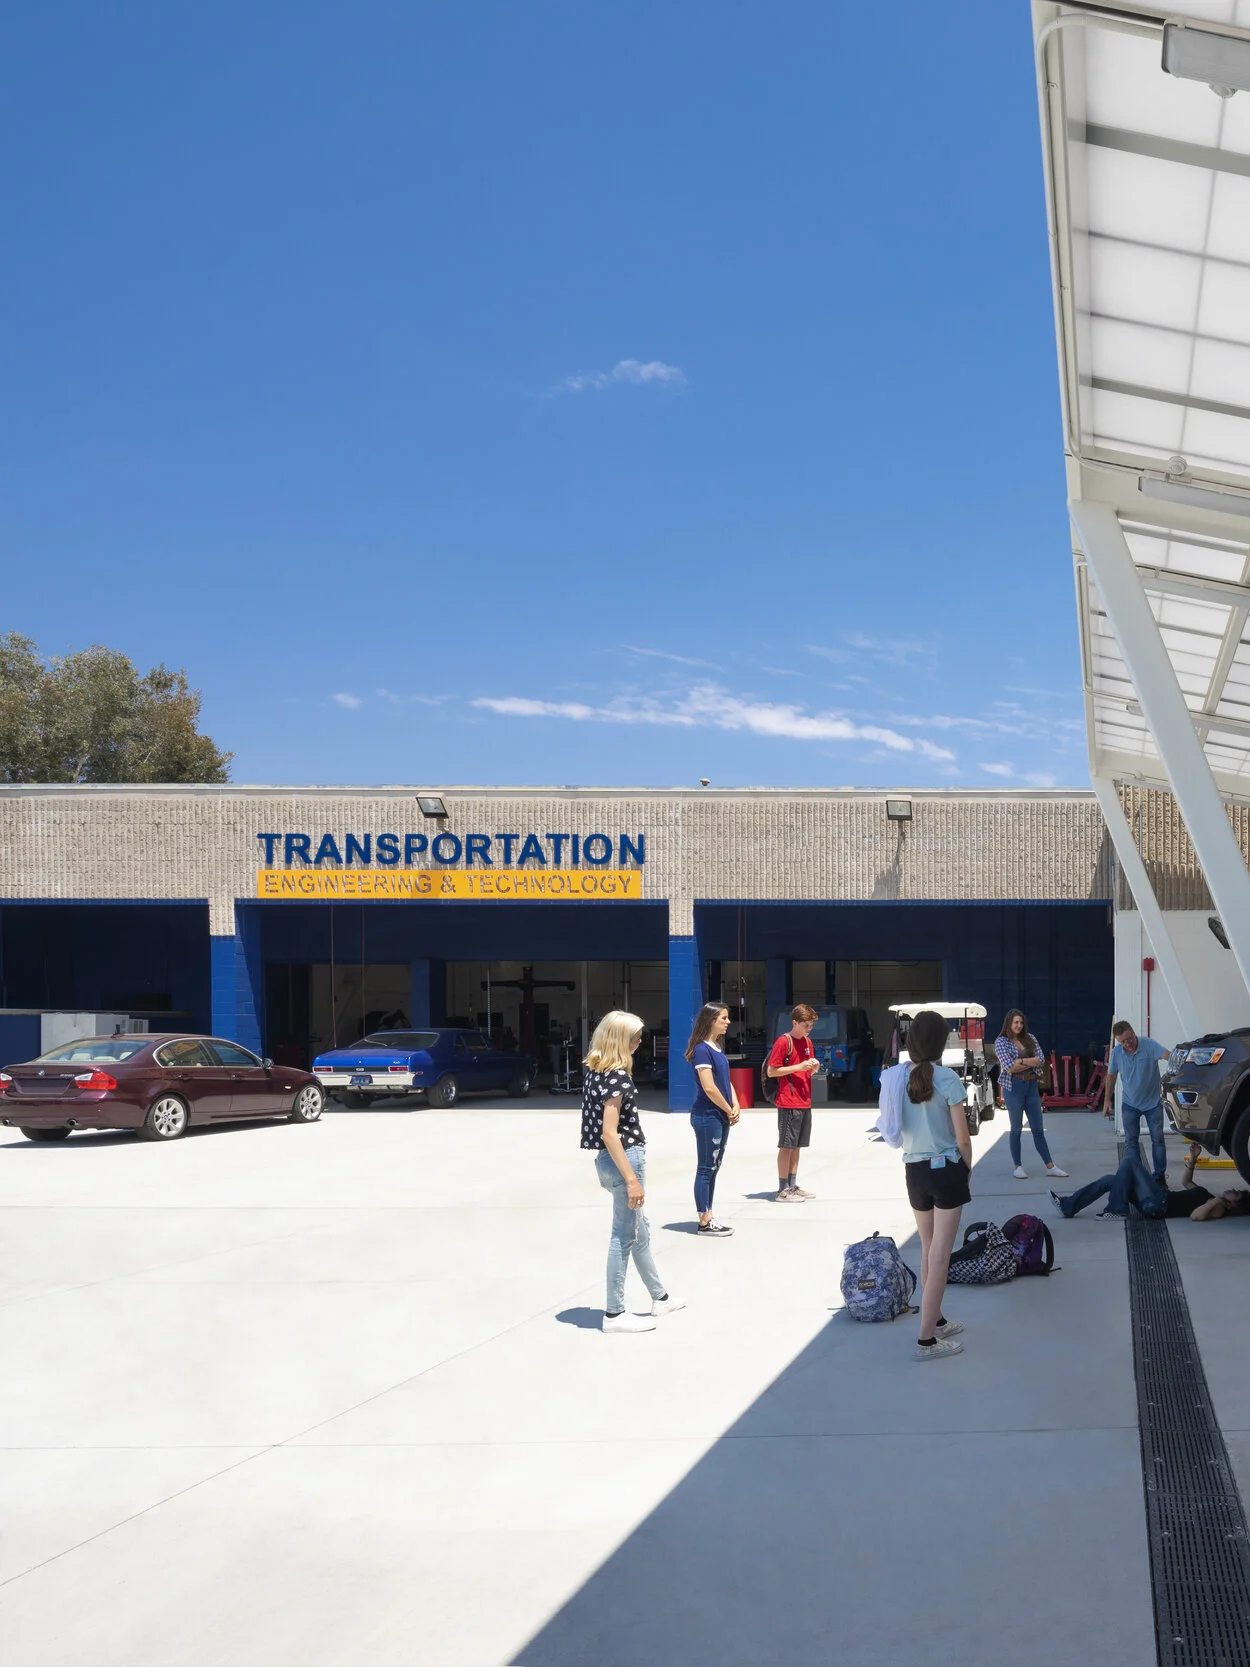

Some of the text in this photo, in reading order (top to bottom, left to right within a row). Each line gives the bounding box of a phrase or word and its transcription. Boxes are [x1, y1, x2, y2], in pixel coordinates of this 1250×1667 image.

[257, 833, 646, 866] TRANSPORTATION
[264, 874, 633, 895] ENGINEERING & TECHNOLOGY
